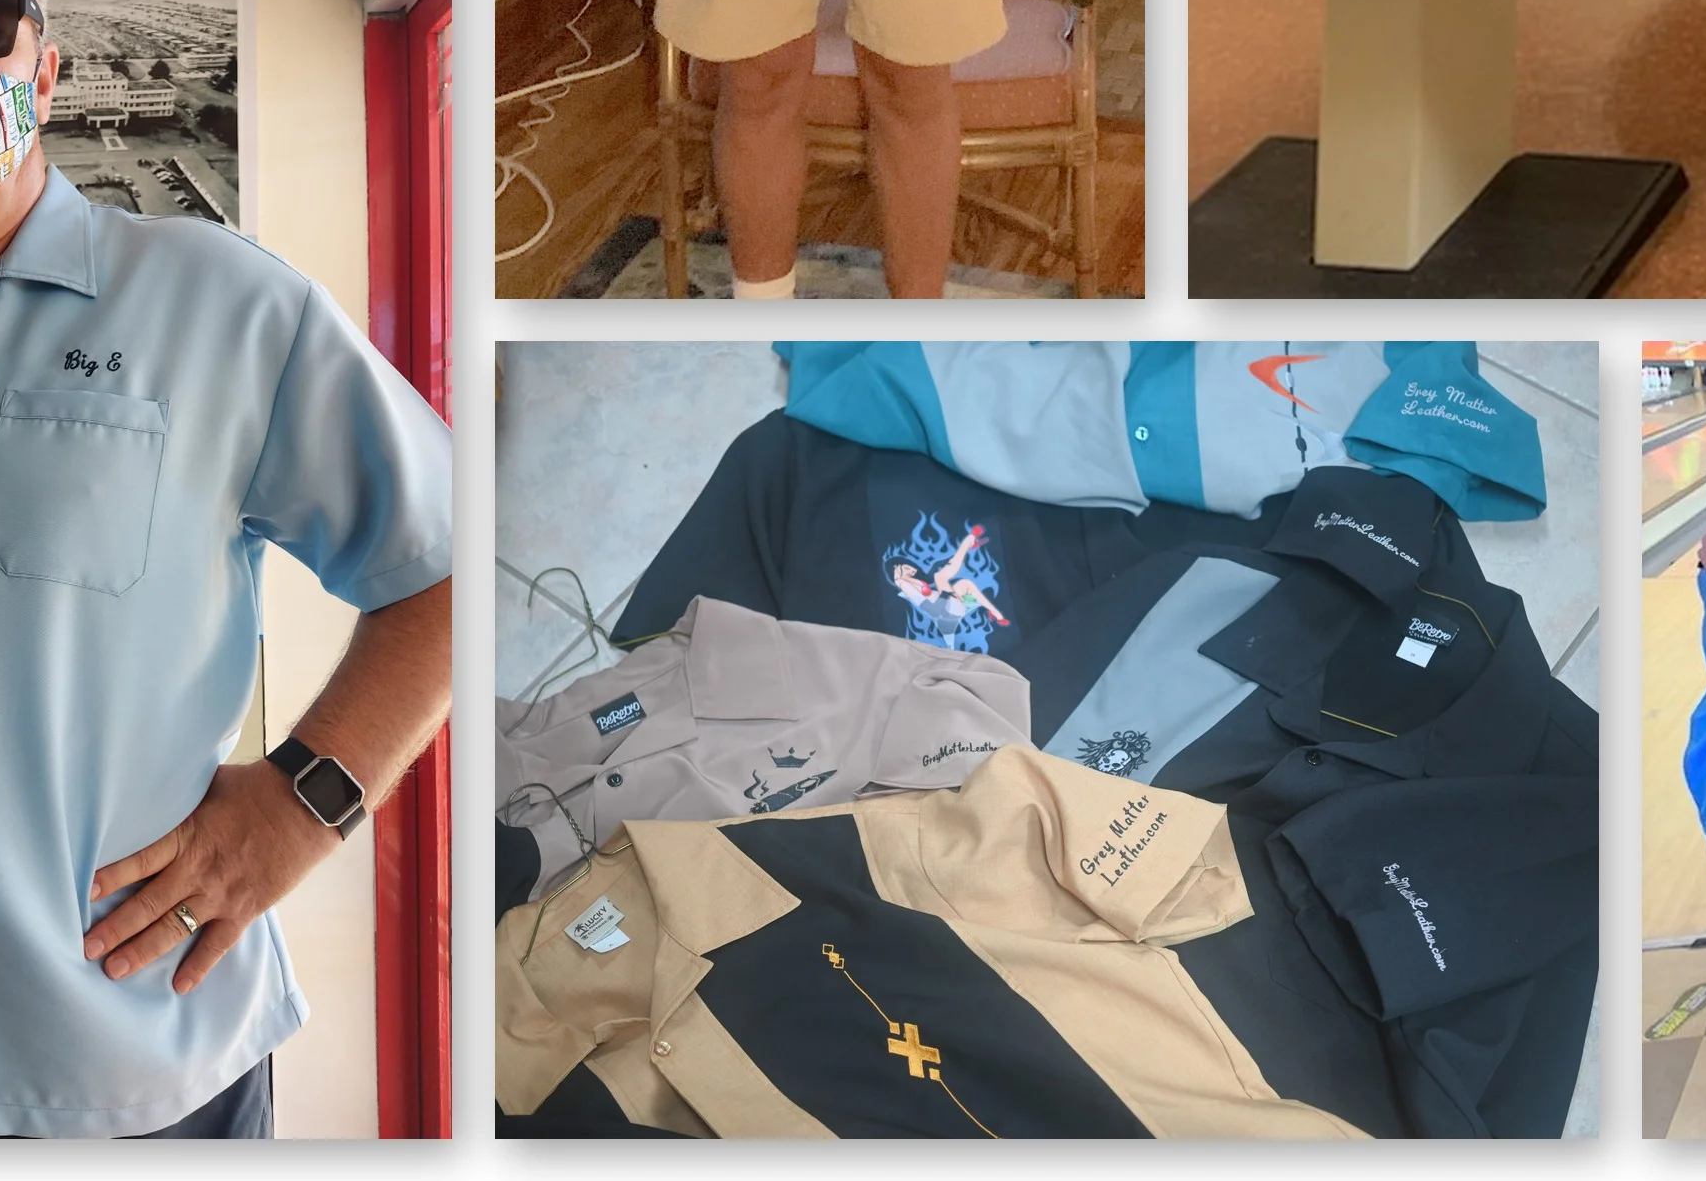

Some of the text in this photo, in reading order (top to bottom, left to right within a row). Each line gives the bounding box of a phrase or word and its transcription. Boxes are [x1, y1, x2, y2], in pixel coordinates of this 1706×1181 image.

[64, 348, 122, 377] Big E
[1404, 381, 1498, 416] Grey Matter
[1400, 399, 1491, 433] Leather.com
[1408, 617, 1452, 642] BeRetro
[596, 701, 641, 730] BeRetro
[1079, 794, 1150, 875] Grey Matter
[1100, 812, 1168, 887] Leather.com
[584, 905, 608, 928] LUCKY
